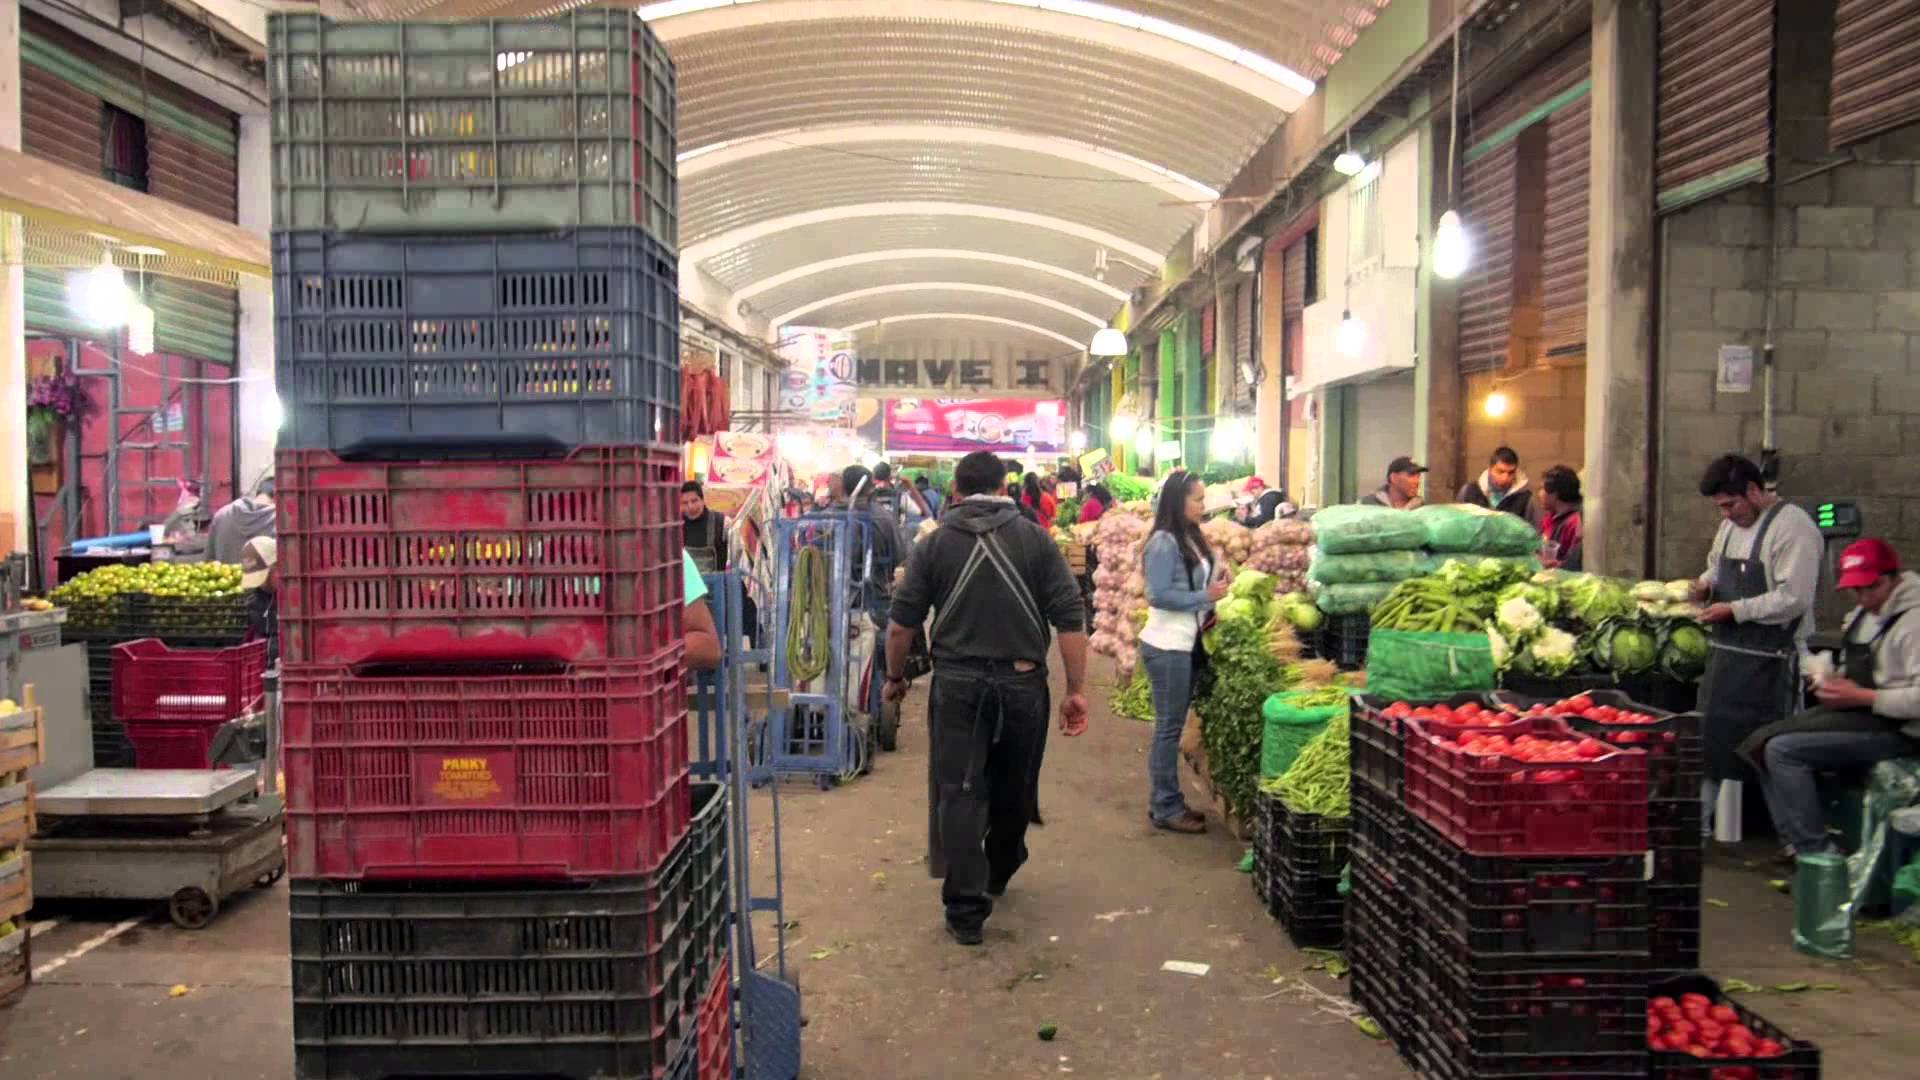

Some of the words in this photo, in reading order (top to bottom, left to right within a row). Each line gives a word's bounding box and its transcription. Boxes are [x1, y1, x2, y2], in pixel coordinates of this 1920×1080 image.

[856, 358, 993, 386] NAVE
[1016, 358, 1050, 386] I
[442, 758, 487, 770] PANKY
